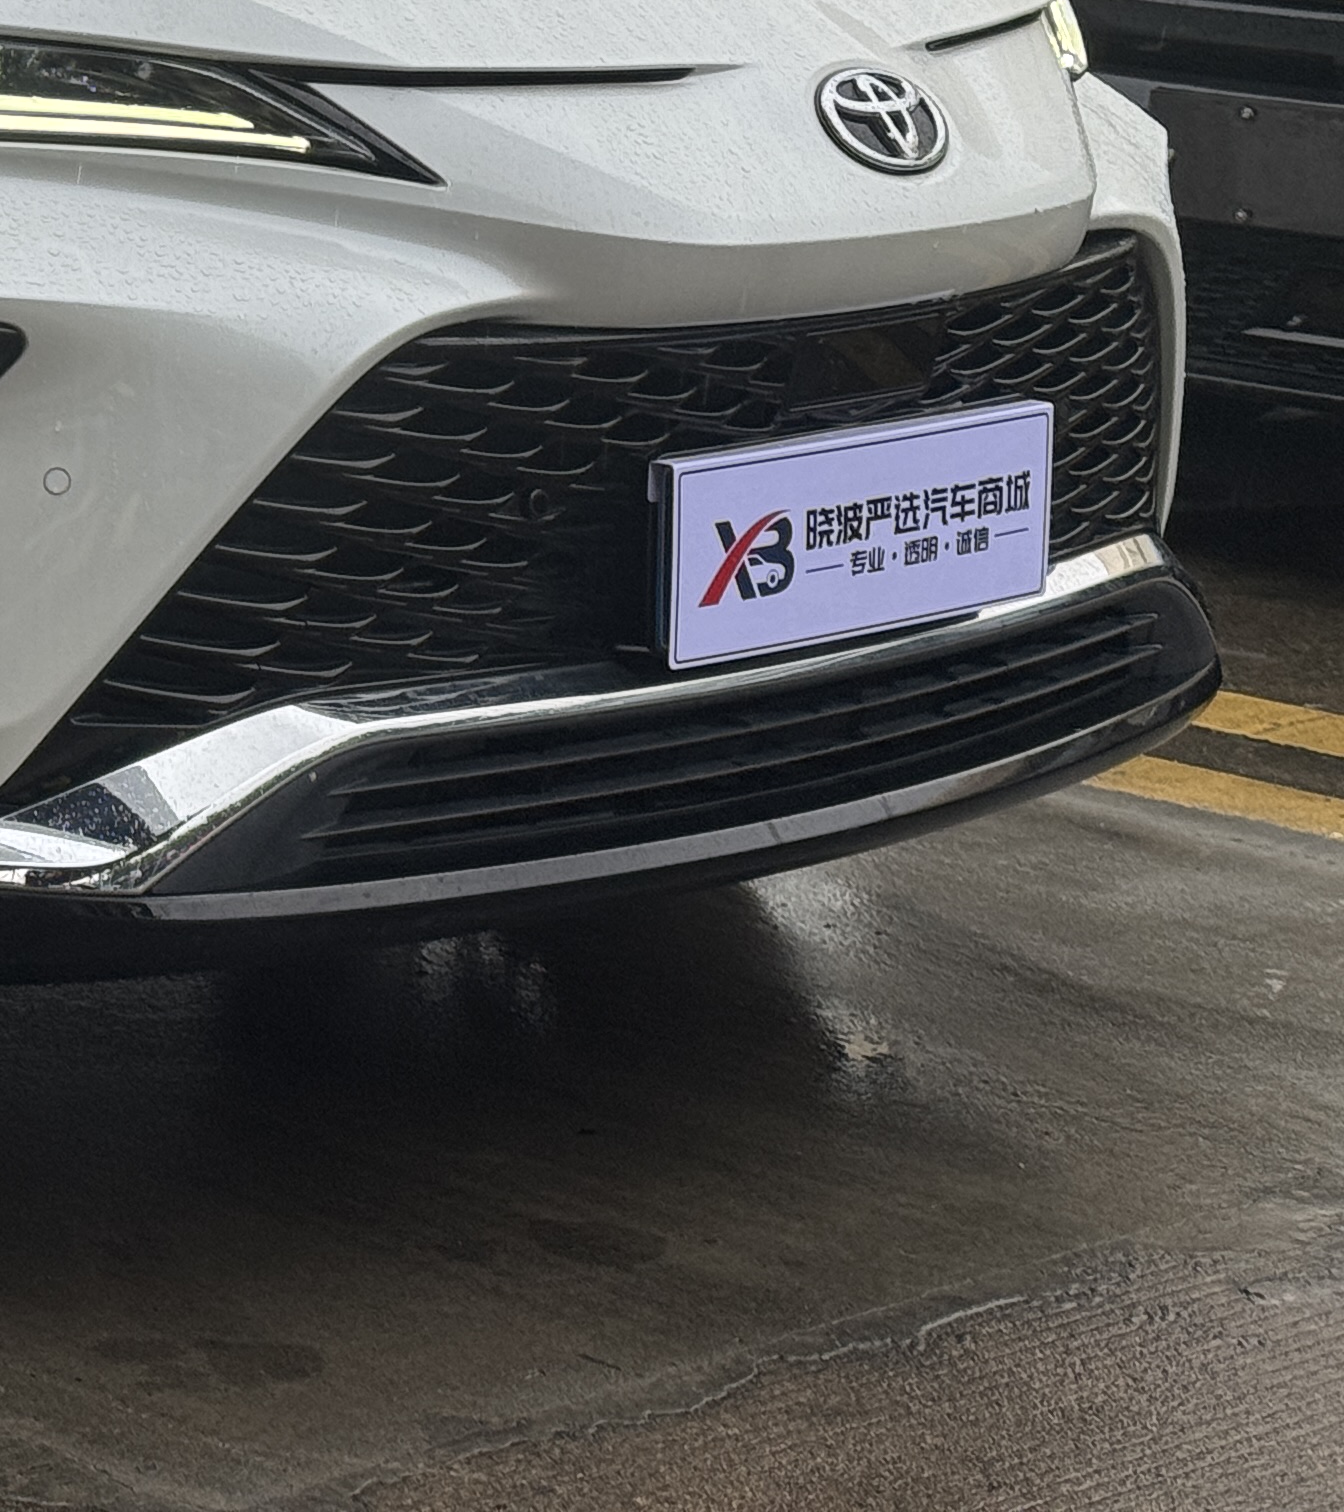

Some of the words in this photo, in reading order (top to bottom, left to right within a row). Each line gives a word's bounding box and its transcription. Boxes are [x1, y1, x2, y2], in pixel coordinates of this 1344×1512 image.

[805, 470, 1031, 551] 晓波严选汽车商城
